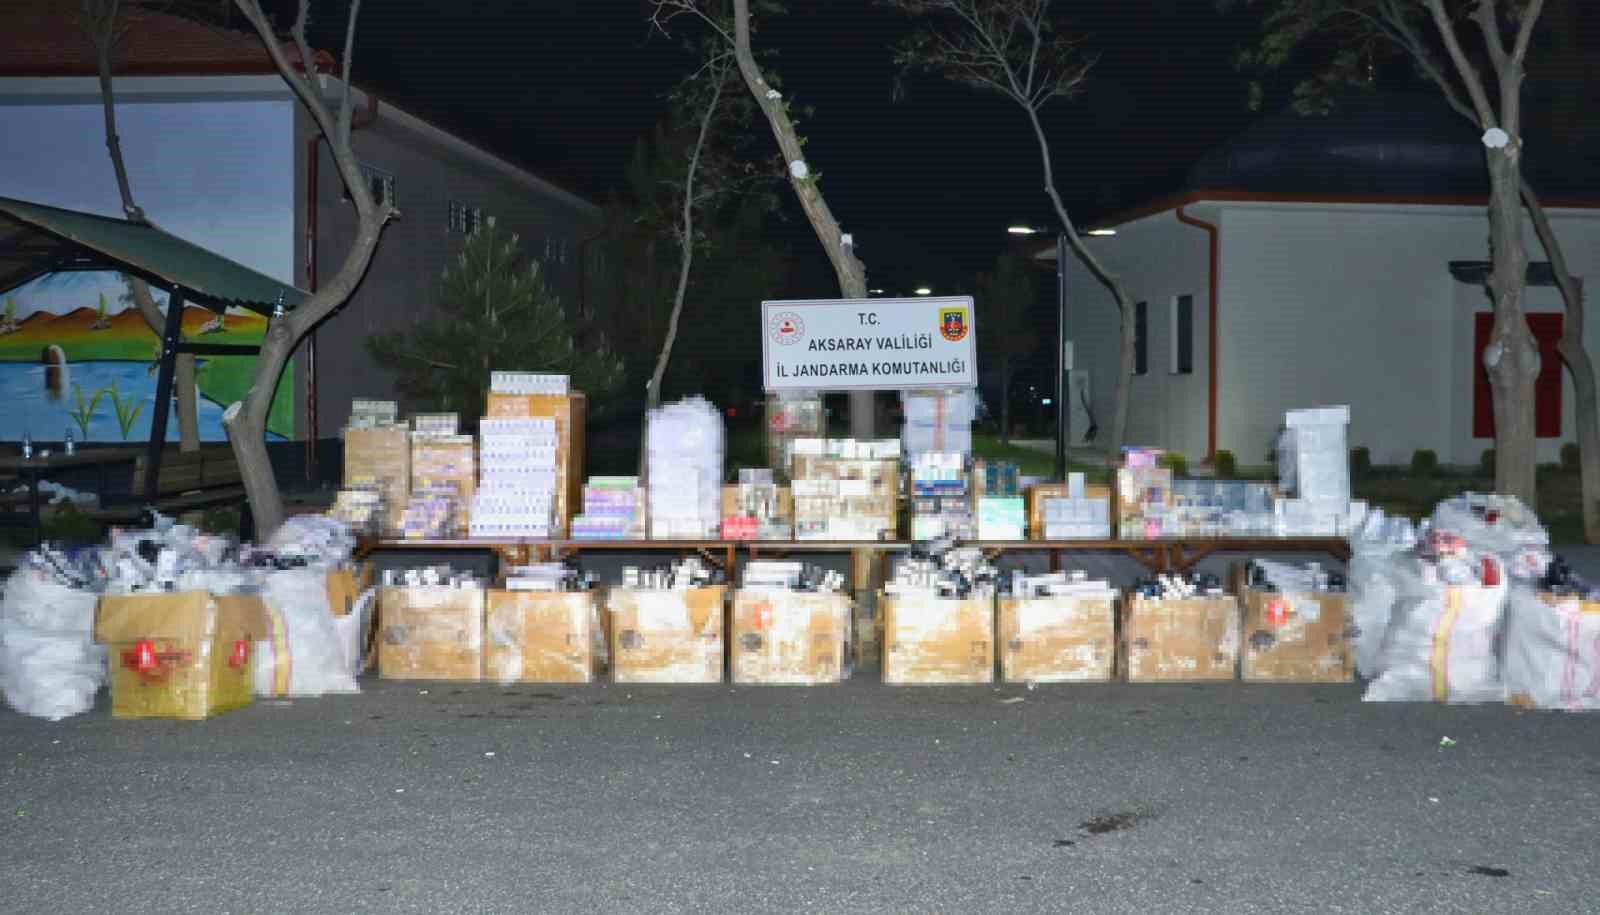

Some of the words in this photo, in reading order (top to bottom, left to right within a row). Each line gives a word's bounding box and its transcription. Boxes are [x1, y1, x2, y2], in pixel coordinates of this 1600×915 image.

[858, 312, 881, 326] T.C.
[808, 337, 873, 352] AKSARAY
[877, 333, 933, 350] VALİLİĞİ
[776, 361, 789, 378] İL
[793, 361, 868, 377] JANDARMA
[873, 358, 966, 376] KOMUTANLIĞI
